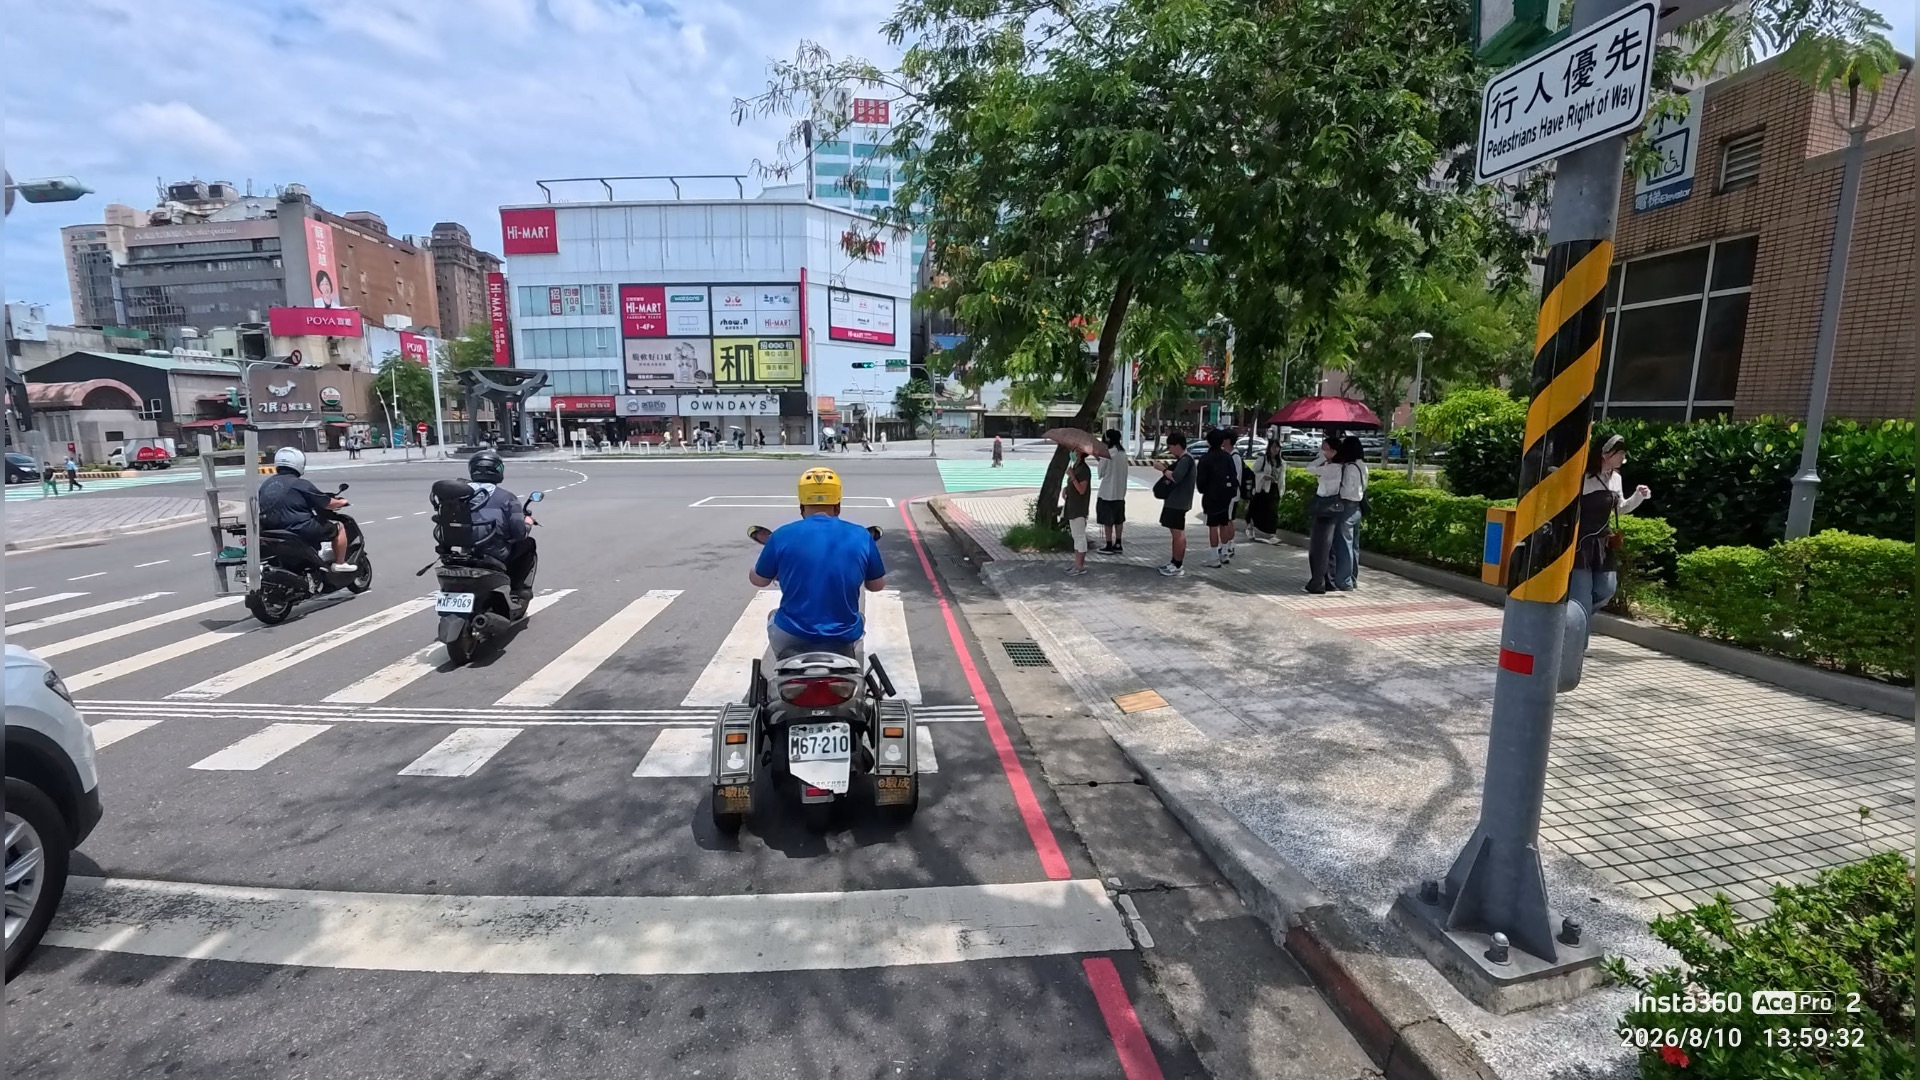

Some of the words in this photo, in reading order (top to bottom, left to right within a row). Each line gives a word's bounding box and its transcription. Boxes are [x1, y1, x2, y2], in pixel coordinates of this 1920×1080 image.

[1490, 27, 1642, 129] 行人優先
[1486, 125, 1537, 161] Pedestrians
[1538, 113, 1564, 140] Have
[1566, 100, 1593, 131] Right
[1596, 95, 1609, 116] of
[1611, 83, 1636, 110] Way
[1635, 190, 1661, 210] 電梯
[1660, 188, 1692, 204] Elevator
[507, 226, 550, 240] Hi-MART
[565, 297, 579, 305] 108
[306, 316, 336, 325] POYA
[764, 319, 792, 327] Hi-MART
[690, 400, 767, 410] OWNDAYS
